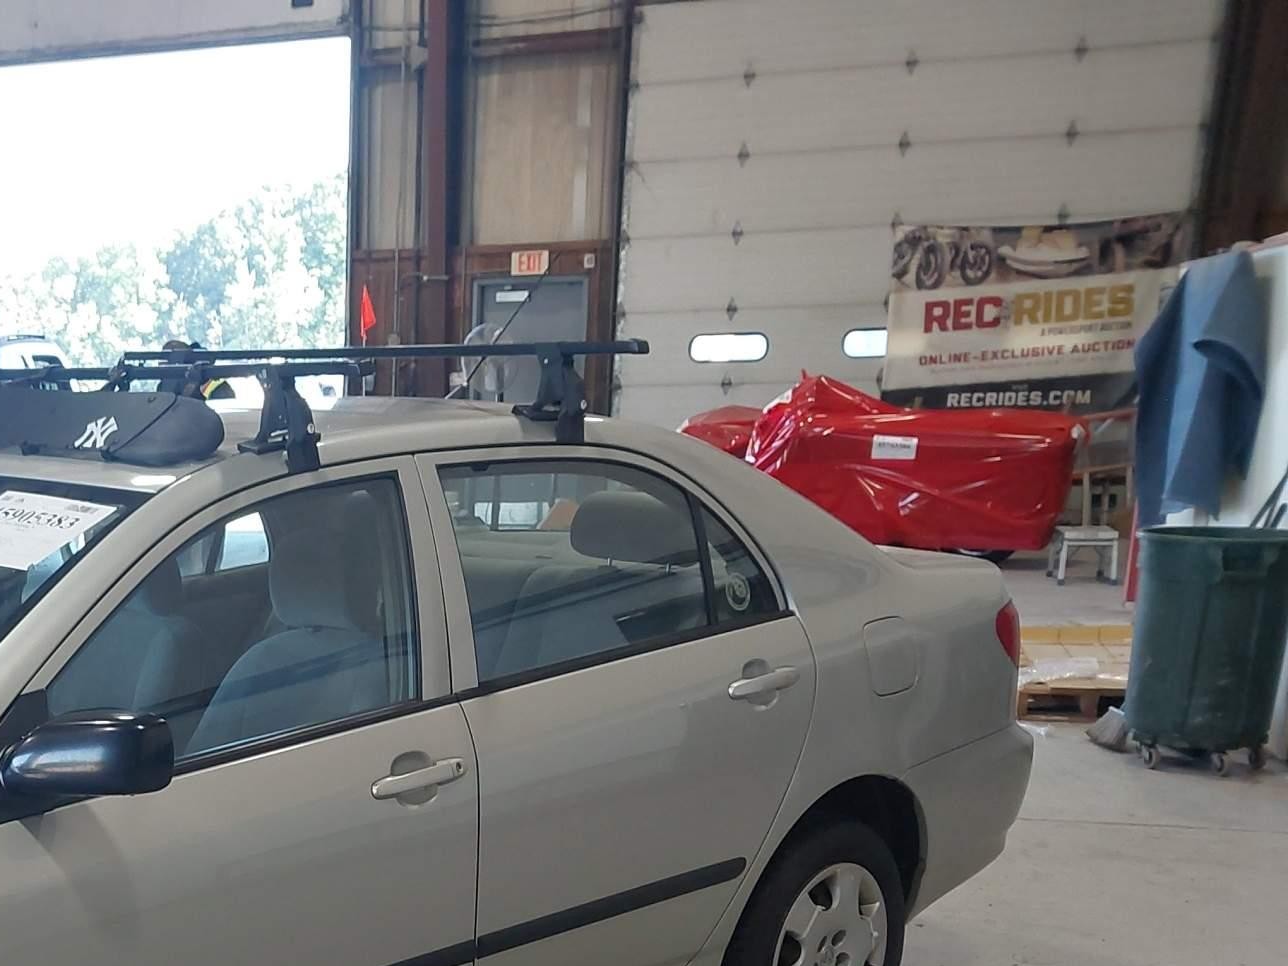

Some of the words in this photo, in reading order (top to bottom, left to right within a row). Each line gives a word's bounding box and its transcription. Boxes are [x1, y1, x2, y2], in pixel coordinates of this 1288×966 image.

[518, 251, 543, 273] EXIT
[923, 295, 1003, 334] REC
[1013, 284, 1136, 327] RIDES
[919, 345, 1065, 366] ONLINE-EXCLUSIVE
[1070, 337, 1136, 354] AUCTION
[946, 389, 1092, 408] RECRIDES.COM
